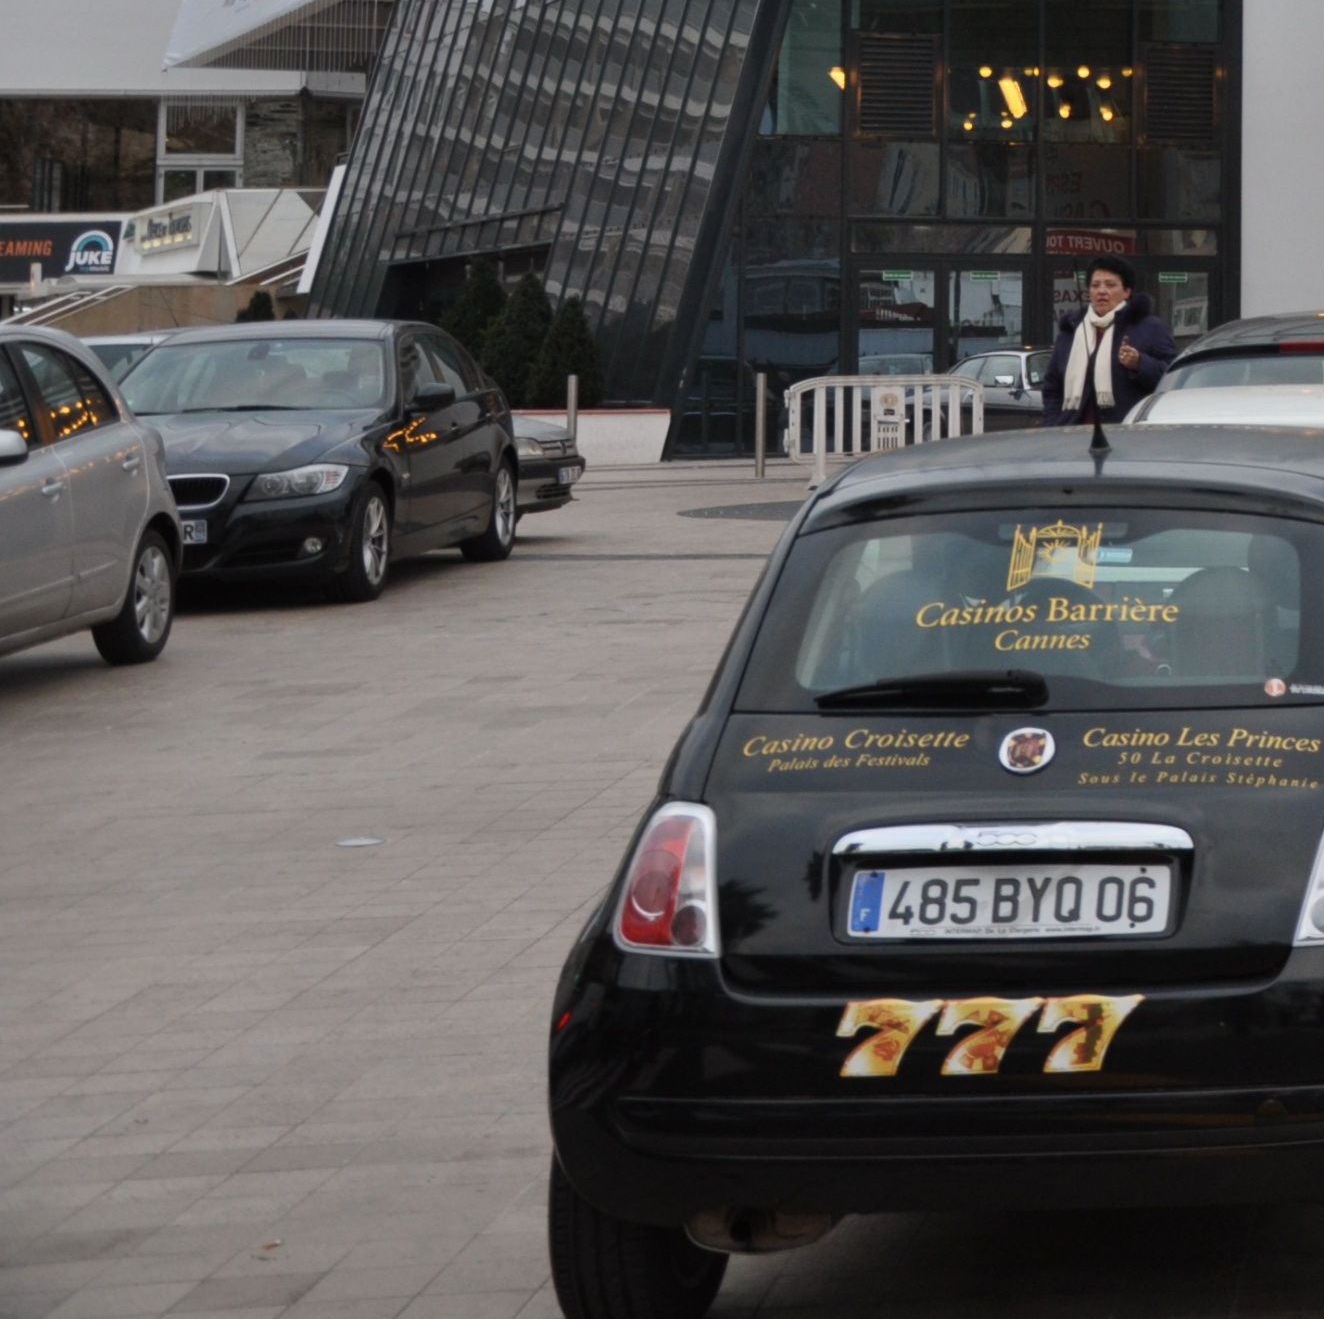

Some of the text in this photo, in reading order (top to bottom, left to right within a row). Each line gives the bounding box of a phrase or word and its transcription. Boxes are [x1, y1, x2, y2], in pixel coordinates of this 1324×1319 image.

[0, 240, 52, 257] EAMING
[65, 251, 113, 272] JUKE
[183, 524, 194, 541] R
[915, 596, 1180, 628] Casinos Barrière
[994, 629, 1091, 651] Cannes
[743, 729, 970, 757] Casino Croisette
[1082, 727, 1322, 753] Casino Les Princes
[767, 753, 931, 772] Palais des Festivals
[1117, 751, 1283, 768] 50 La Croisette
[1078, 771, 1319, 789] Sous le Palais Stéphanie
[860, 876, 1157, 926] F 485 BYQ 06
[836, 994, 1146, 1076] 777
